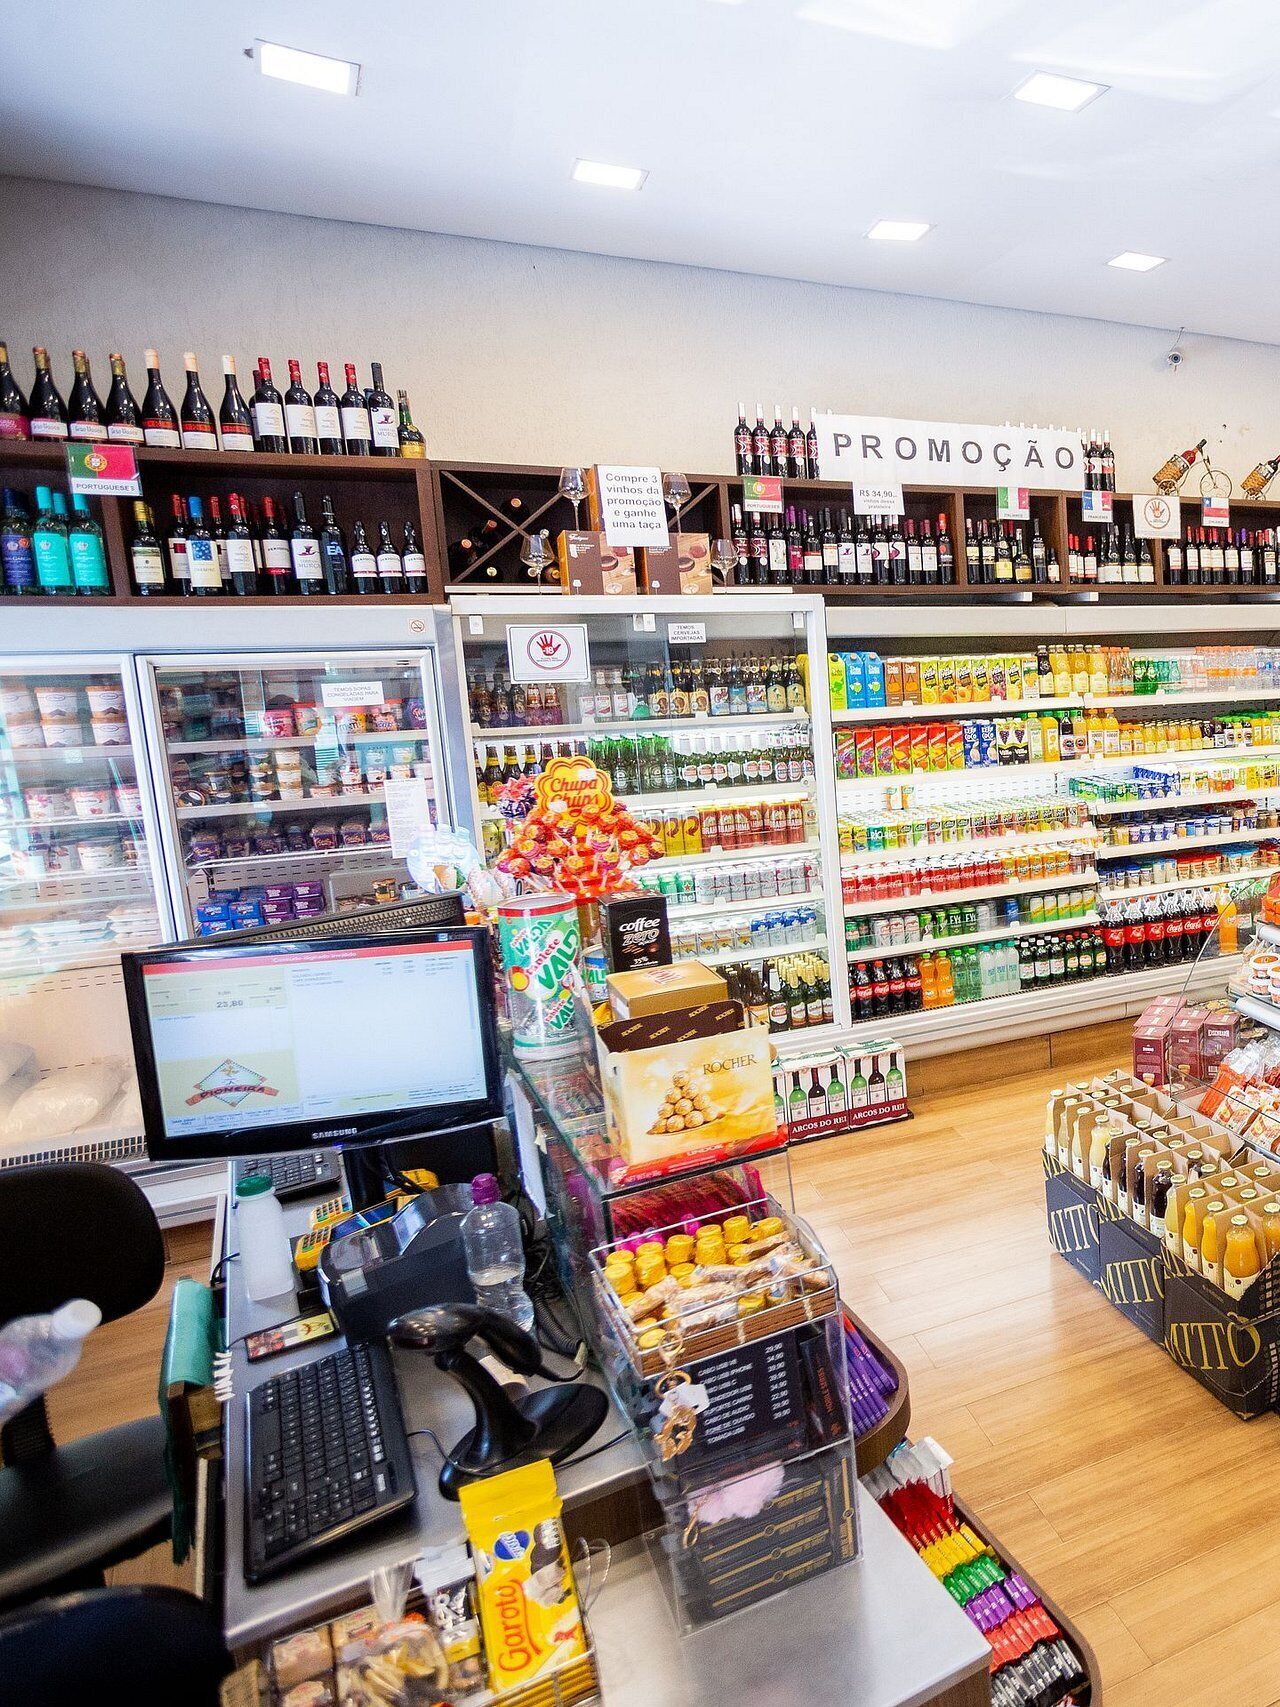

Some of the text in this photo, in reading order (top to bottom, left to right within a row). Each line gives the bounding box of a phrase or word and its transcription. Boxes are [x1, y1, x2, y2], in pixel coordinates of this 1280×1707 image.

[833, 432, 1075, 472] PROMOÇÃO
[605, 473, 658, 484] Compre 3
[607, 485, 660, 495] vinhos da
[859, 490, 870, 498] R$
[607, 497, 662, 507] promoção
[624, 508, 657, 519] ganhe
[612, 520, 661, 531] uma taça
[327, 546, 344, 556] EA
[550, 778, 597, 795] Chupa
[619, 917, 661, 932] coffee
[622, 928, 661, 946] zero
[538, 929, 580, 990] VALD
[715, 1008, 735, 1021] ROCHER
[621, 1023, 643, 1037] ROCHER
[650, 1026, 671, 1040] ROCHER
[703, 1054, 757, 1074] ROCHER
[200, 1086, 265, 1099] PIONEIRA
[853, 1103, 906, 1120] ARCOS DO REI
[792, 1116, 847, 1134] ARCOS DO REI
[312, 1127, 358, 1140] SAMSUNG
[1165, 1311, 1261, 1370] MITTO
[498, 1584, 532, 1672] Garoto
